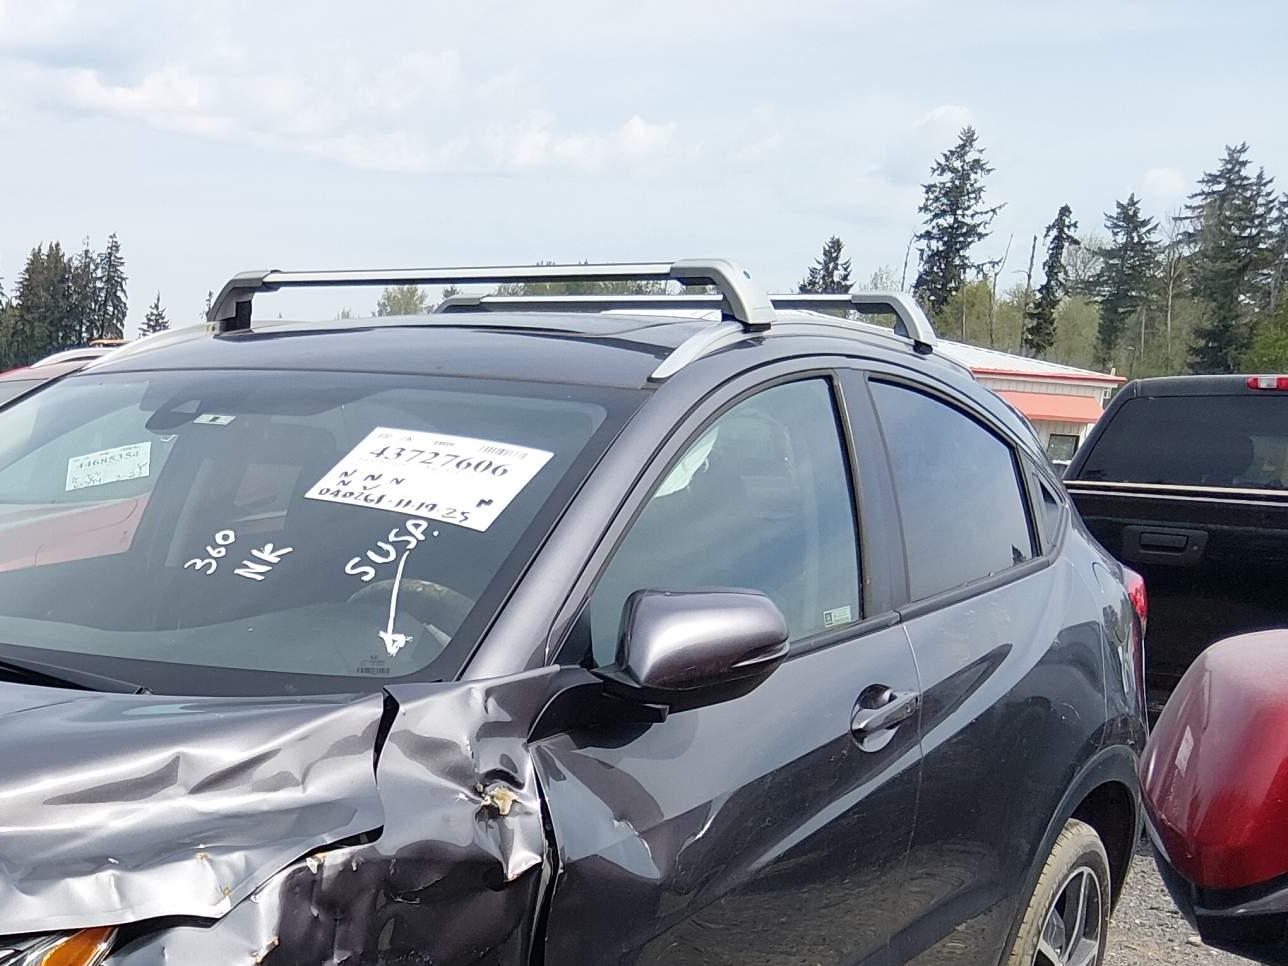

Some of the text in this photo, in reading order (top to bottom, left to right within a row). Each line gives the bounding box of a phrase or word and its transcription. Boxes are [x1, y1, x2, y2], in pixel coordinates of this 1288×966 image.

[369, 445, 510, 477] 43727606
[184, 529, 236, 575] 360
[234, 543, 294, 581] NK
